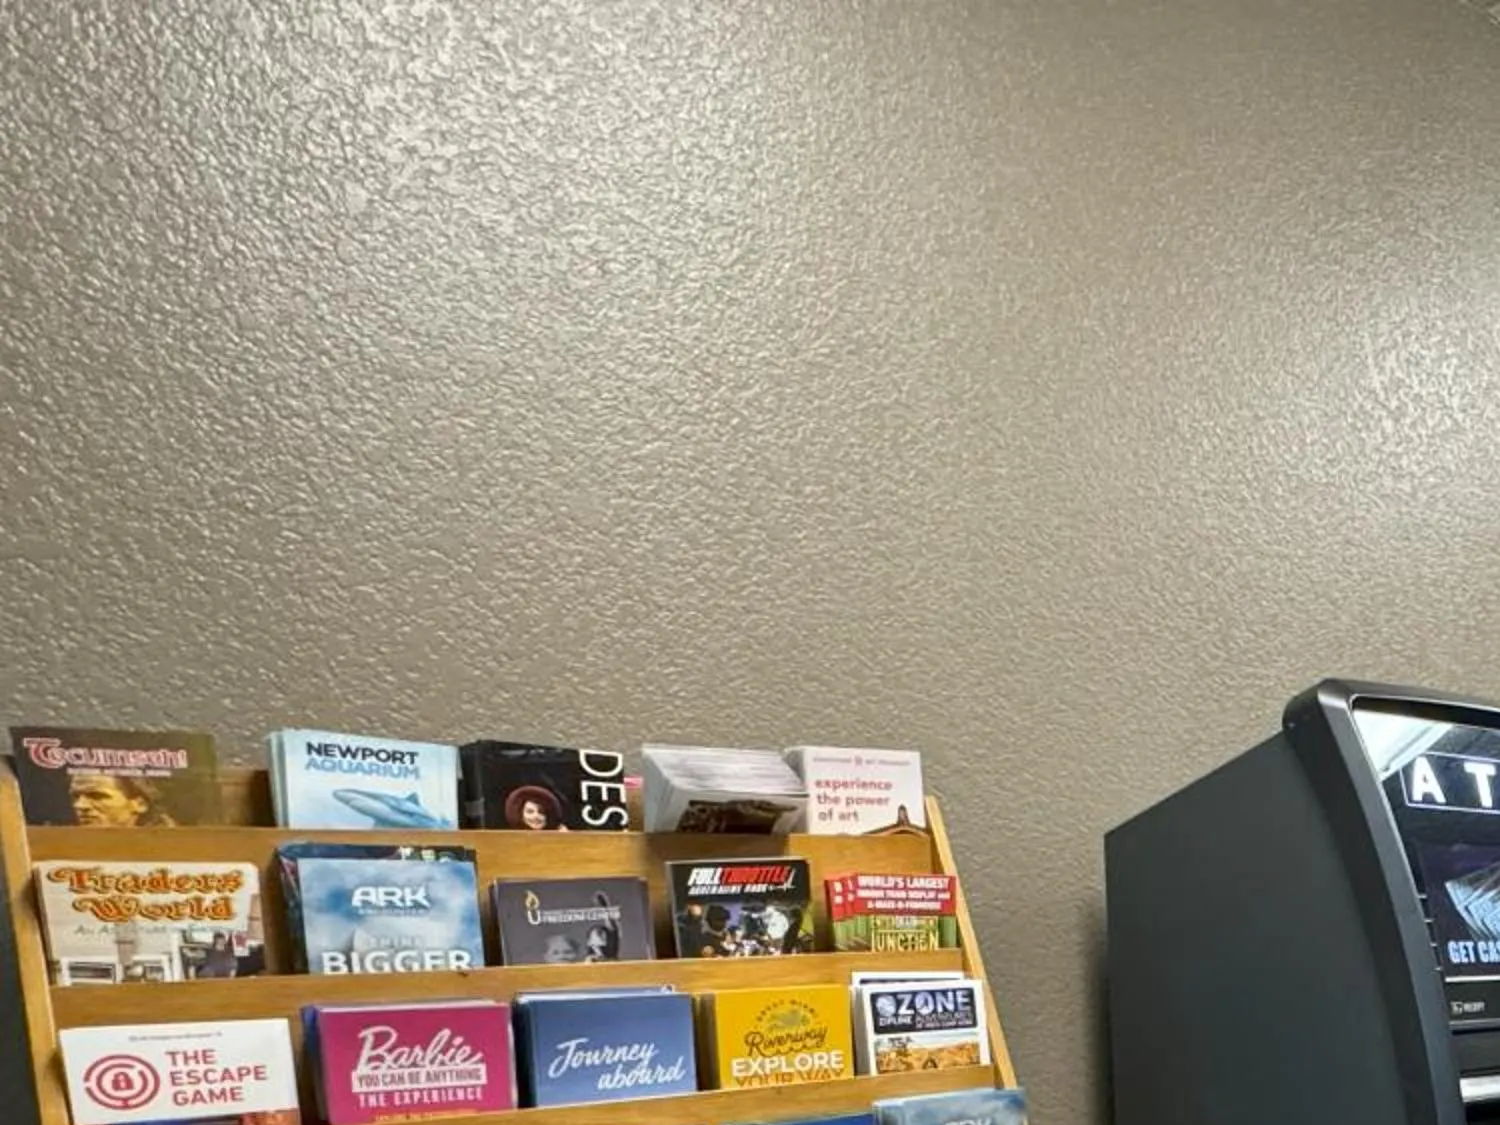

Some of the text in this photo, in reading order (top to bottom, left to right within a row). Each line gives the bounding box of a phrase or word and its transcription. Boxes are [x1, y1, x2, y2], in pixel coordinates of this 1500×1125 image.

[306, 741, 419, 765] NEWPORT
[304, 758, 421, 781] AQUARIUM
[815, 777, 894, 792] experience
[816, 792, 891, 808] the power
[818, 809, 859, 822] of art
[47, 867, 245, 894] Traders
[687, 866, 722, 887] FULL
[857, 875, 904, 889] WORLD'S
[351, 884, 431, 908] ARK
[72, 896, 237, 921] World
[320, 949, 473, 975] BIGGER
[1448, 940, 1475, 964] GET
[874, 987, 973, 1016] OZONE
[165, 1048, 217, 1067] THE
[357, 1024, 484, 1073] Barbie
[547, 1037, 660, 1079] Journey
[596, 1055, 687, 1091] aboard
[730, 1050, 845, 1078] EXPLORE
[170, 1065, 267, 1087] ESCAPE
[357, 1067, 483, 1087] YOU CAN BE ANYTHING
[173, 1087, 246, 1107] GAME
[358, 1087, 483, 1108] THE EXPERIENCE
